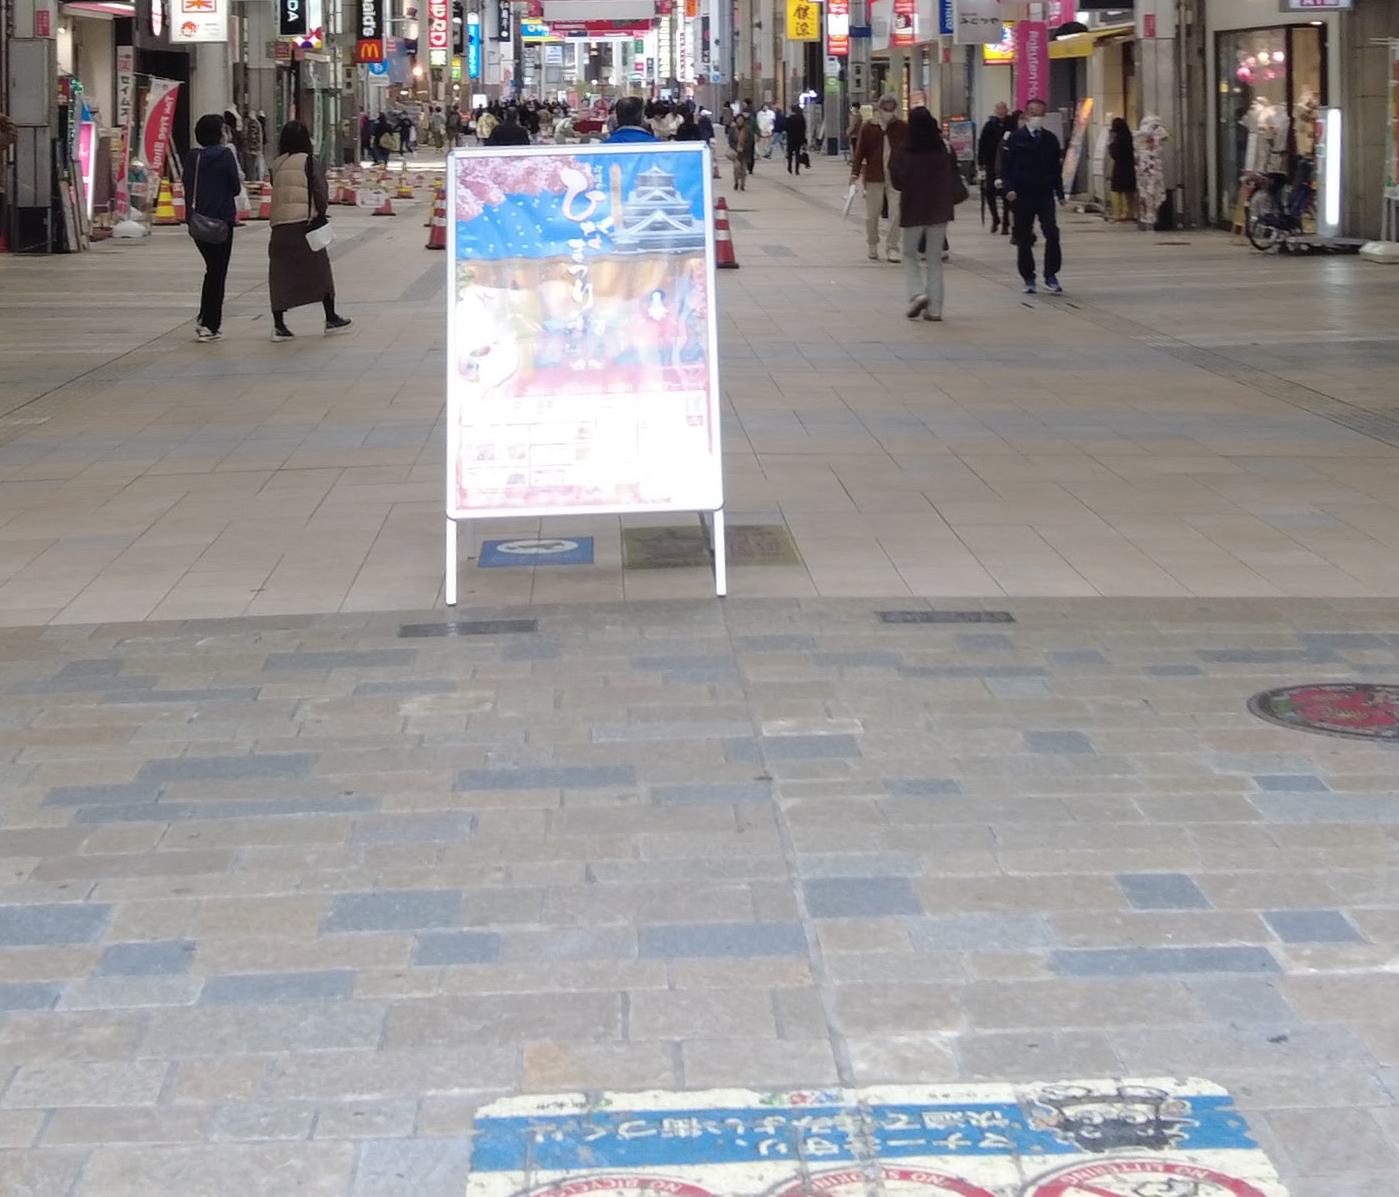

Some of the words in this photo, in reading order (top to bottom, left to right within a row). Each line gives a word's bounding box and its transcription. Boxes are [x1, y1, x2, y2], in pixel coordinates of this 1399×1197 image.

[120, 75, 132, 126] セイムス
[909, 1170, 944, 1186] NO
[1058, 1161, 1167, 1187] LITTERING
[1175, 1163, 1209, 1180] NO
[649, 1177, 683, 1195] NO
